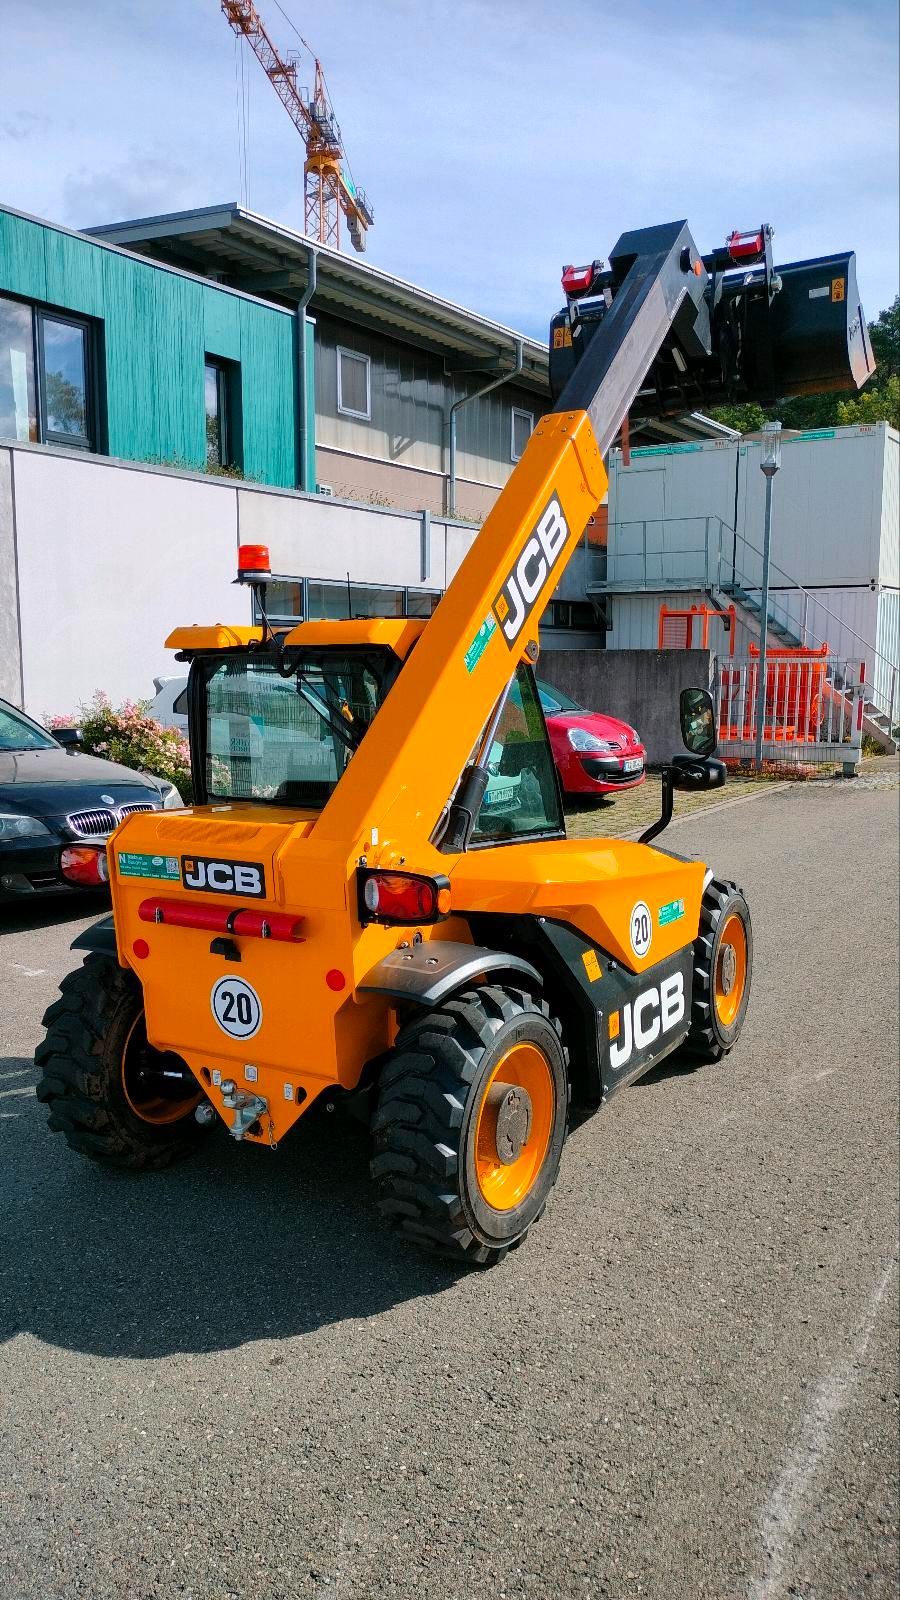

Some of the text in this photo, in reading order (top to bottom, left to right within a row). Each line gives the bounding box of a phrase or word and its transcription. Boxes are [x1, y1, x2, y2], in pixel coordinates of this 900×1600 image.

[504, 499, 567, 641] JCB
[185, 861, 262, 894] JCB
[634, 914, 649, 946] 20
[220, 991, 253, 1025] 20
[609, 971, 685, 1069] JCB
